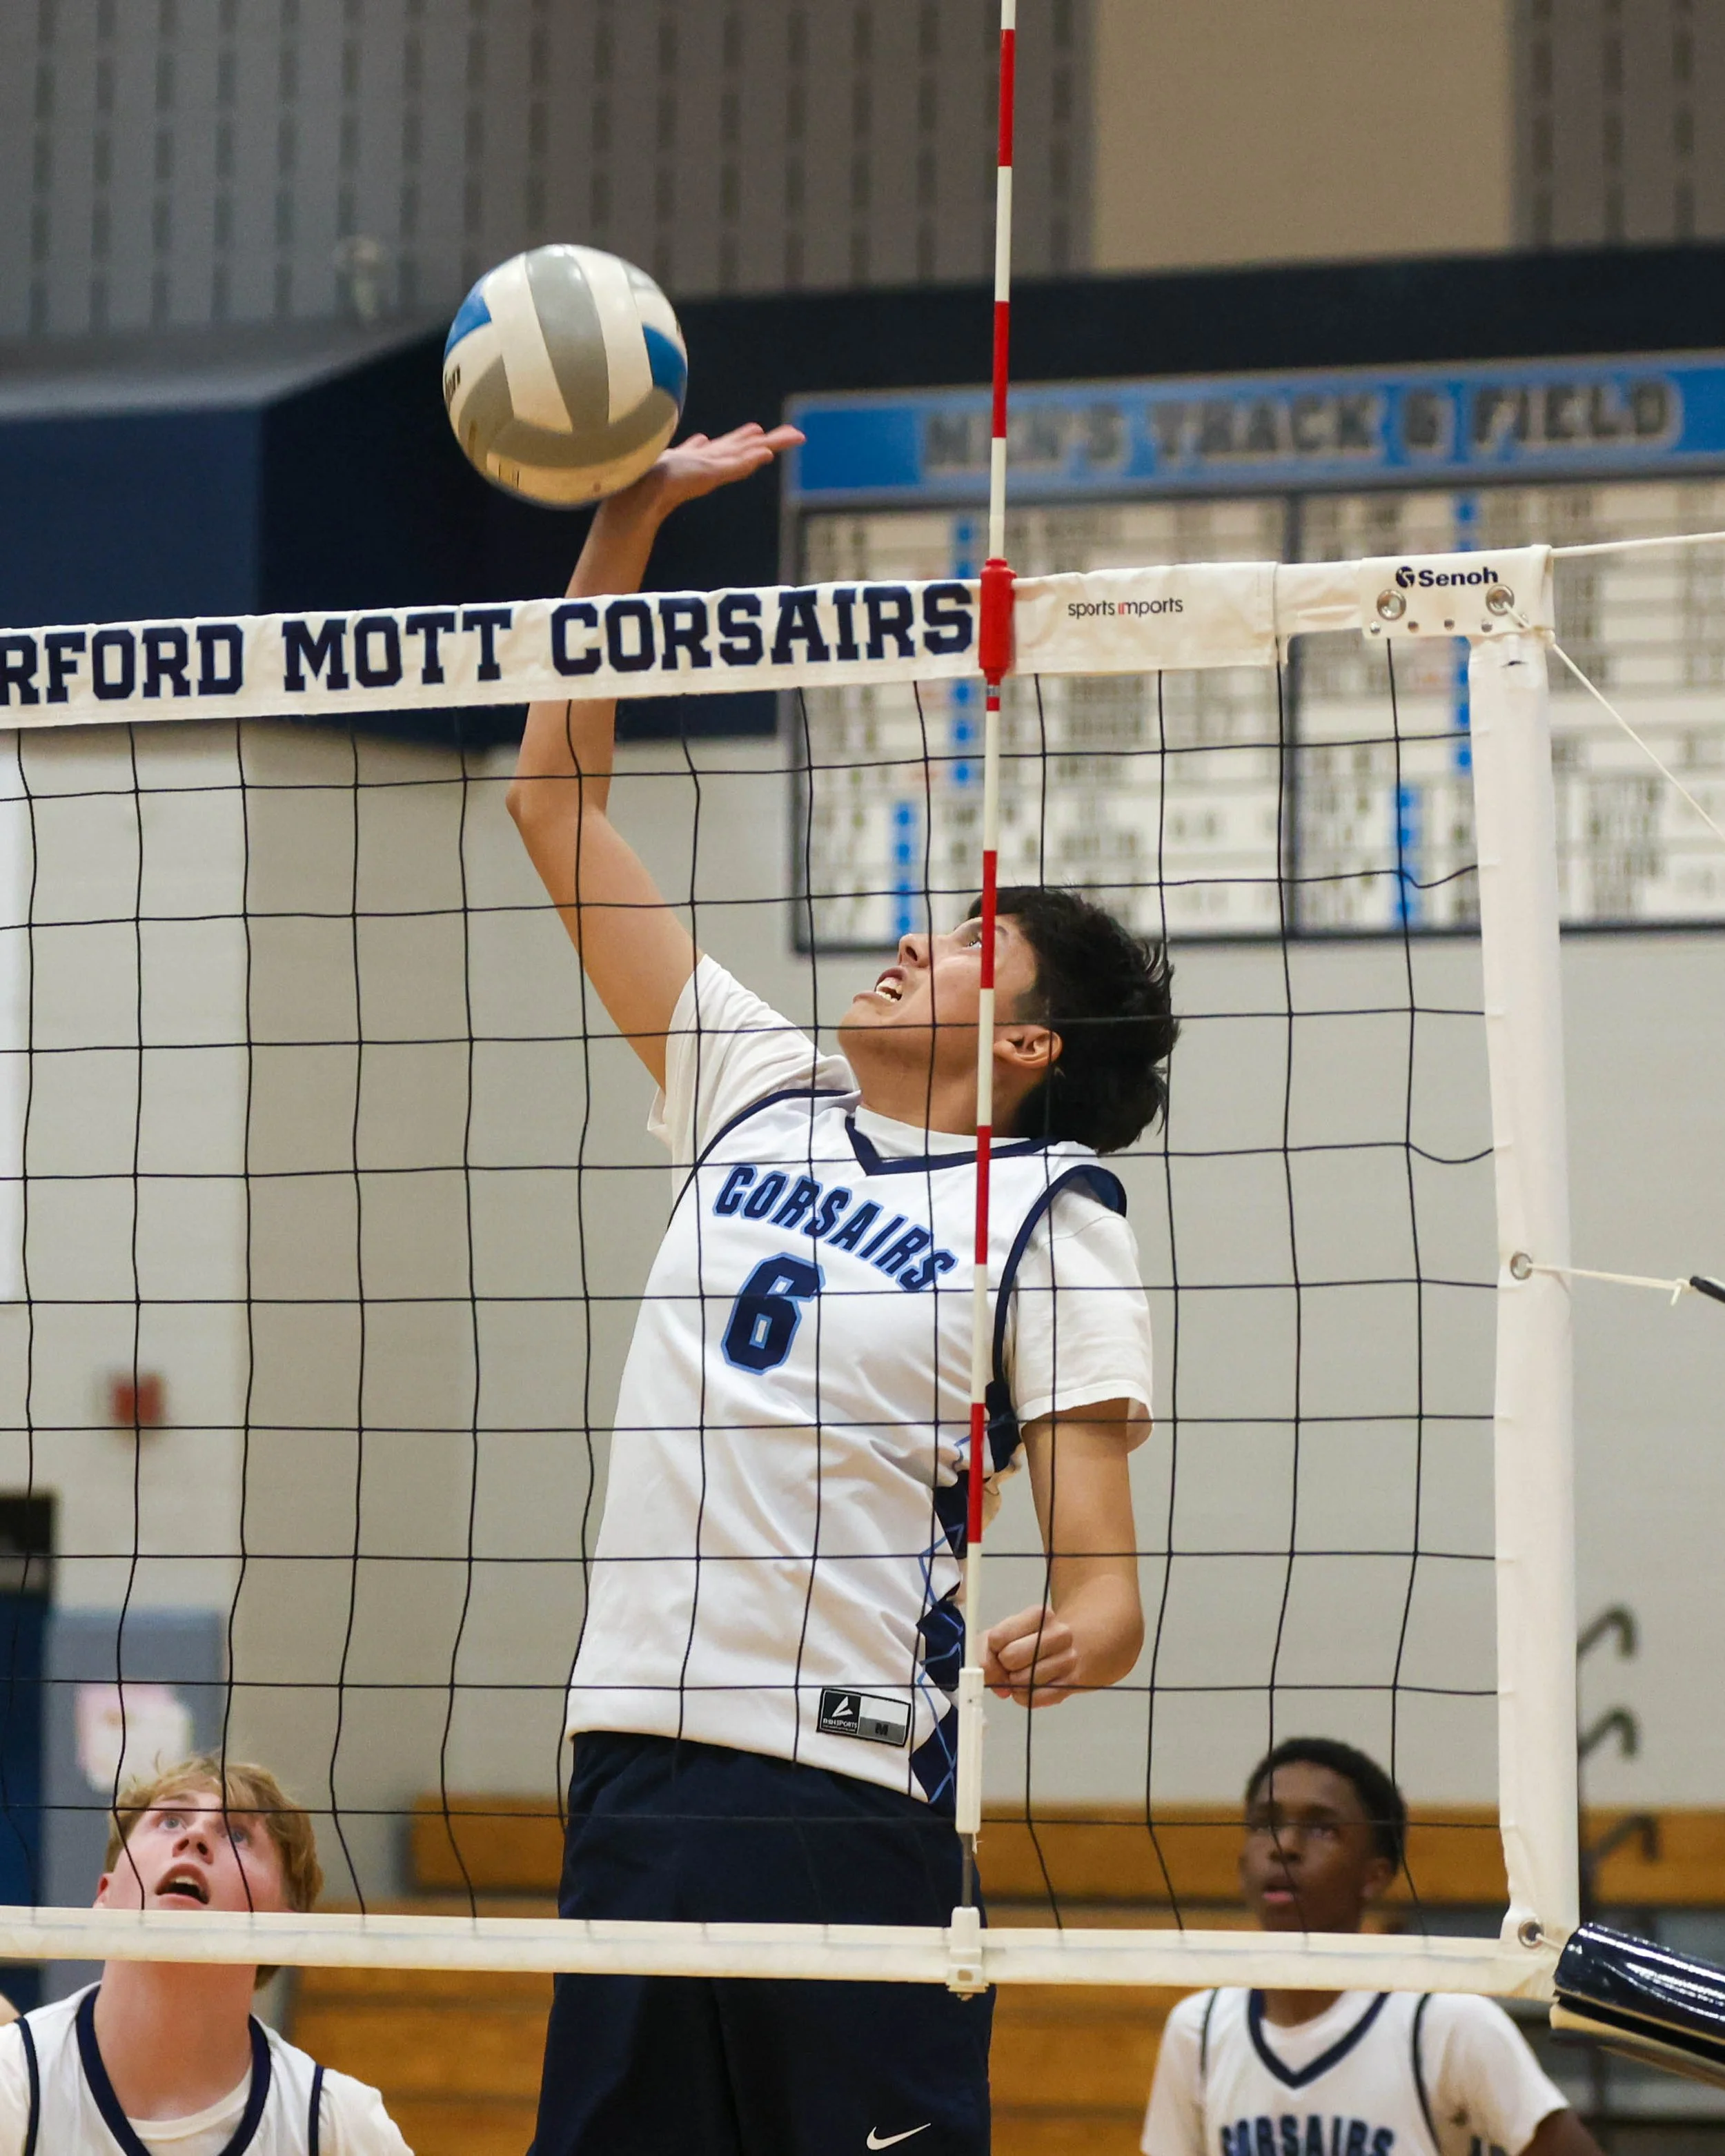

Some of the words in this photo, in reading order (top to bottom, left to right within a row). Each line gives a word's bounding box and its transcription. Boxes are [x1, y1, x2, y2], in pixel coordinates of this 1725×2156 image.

[1151, 392, 1376, 458] TRACK
[1471, 377, 1673, 443] FIELD
[1068, 600, 1115, 619] sports
[1118, 597, 1183, 617] imports
[1419, 566, 1498, 587] Senoh
[0, 624, 244, 705] RFORD
[282, 609, 513, 691] MOTT
[551, 583, 973, 676] CORSAIRS
[713, 1165, 959, 1293] CORSAIRS
[720, 1252, 826, 1376] 6
[875, 1722, 889, 1737] M
